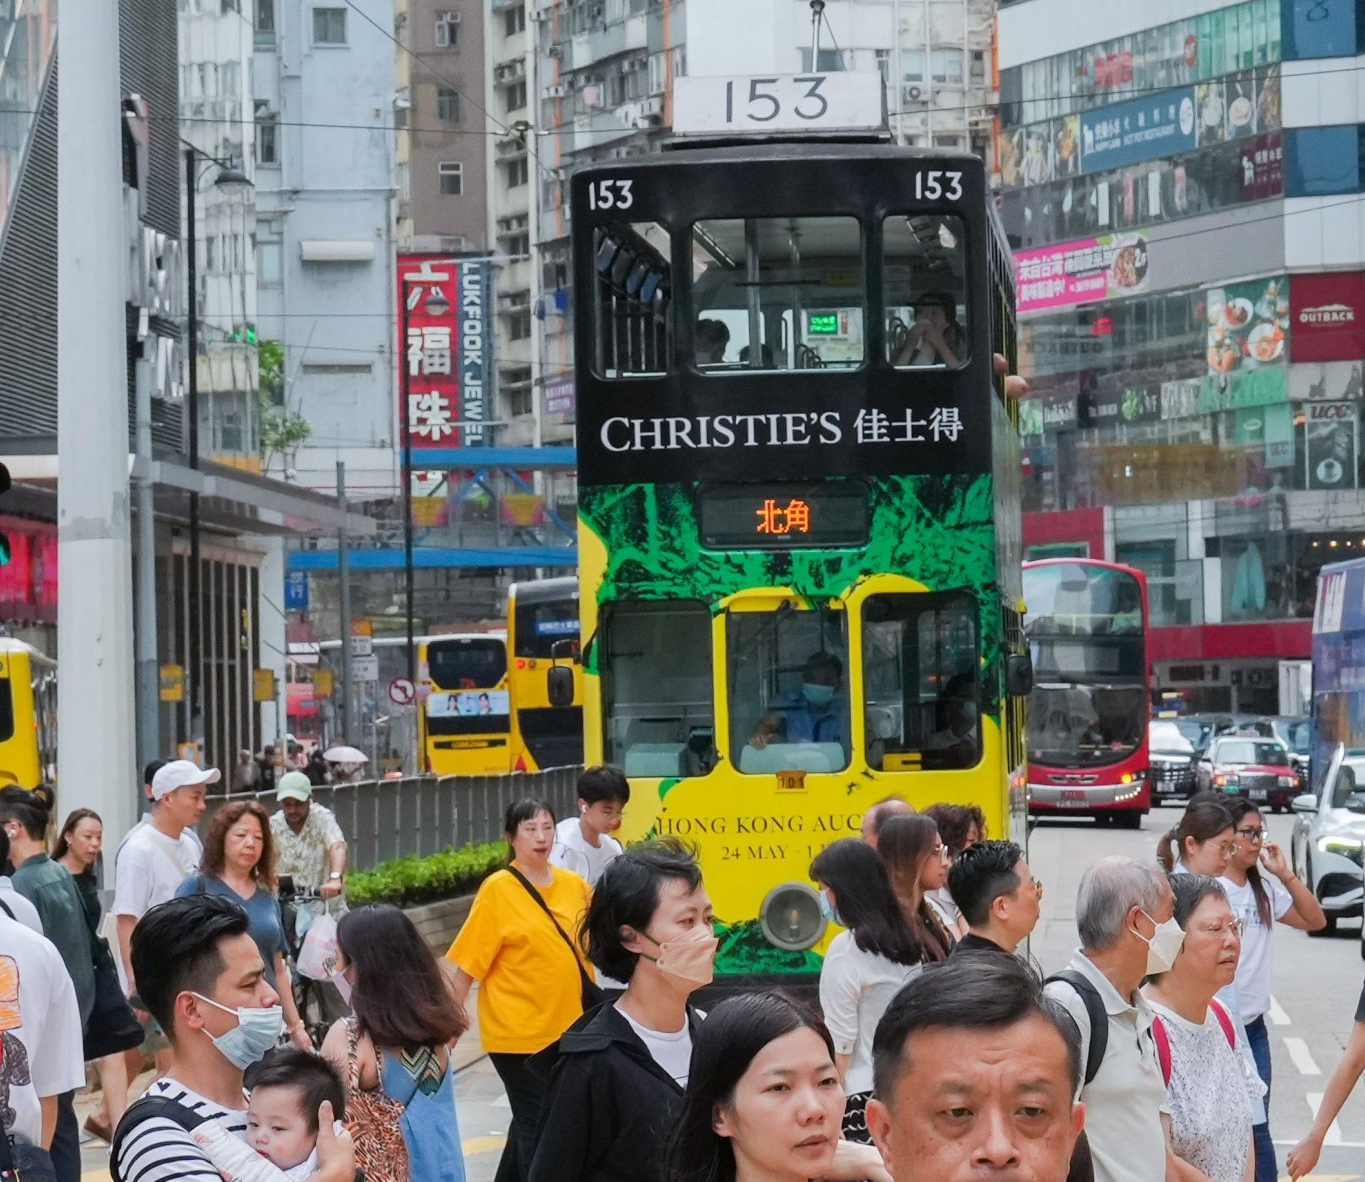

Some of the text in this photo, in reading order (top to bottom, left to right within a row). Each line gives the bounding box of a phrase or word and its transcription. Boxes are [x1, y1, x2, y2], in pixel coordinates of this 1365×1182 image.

[726, 76, 828, 123] 153
[588, 181, 633, 210] 153
[915, 171, 962, 201] 153
[1300, 312, 1355, 323] OUTBACK
[600, 407, 964, 452] CHRISTIE'S 佳士得
[756, 499, 810, 533] 北角
[658, 814, 865, 837] HONG KONG AUC
[721, 845, 741, 861] 24
[747, 844, 787, 861] MAY
